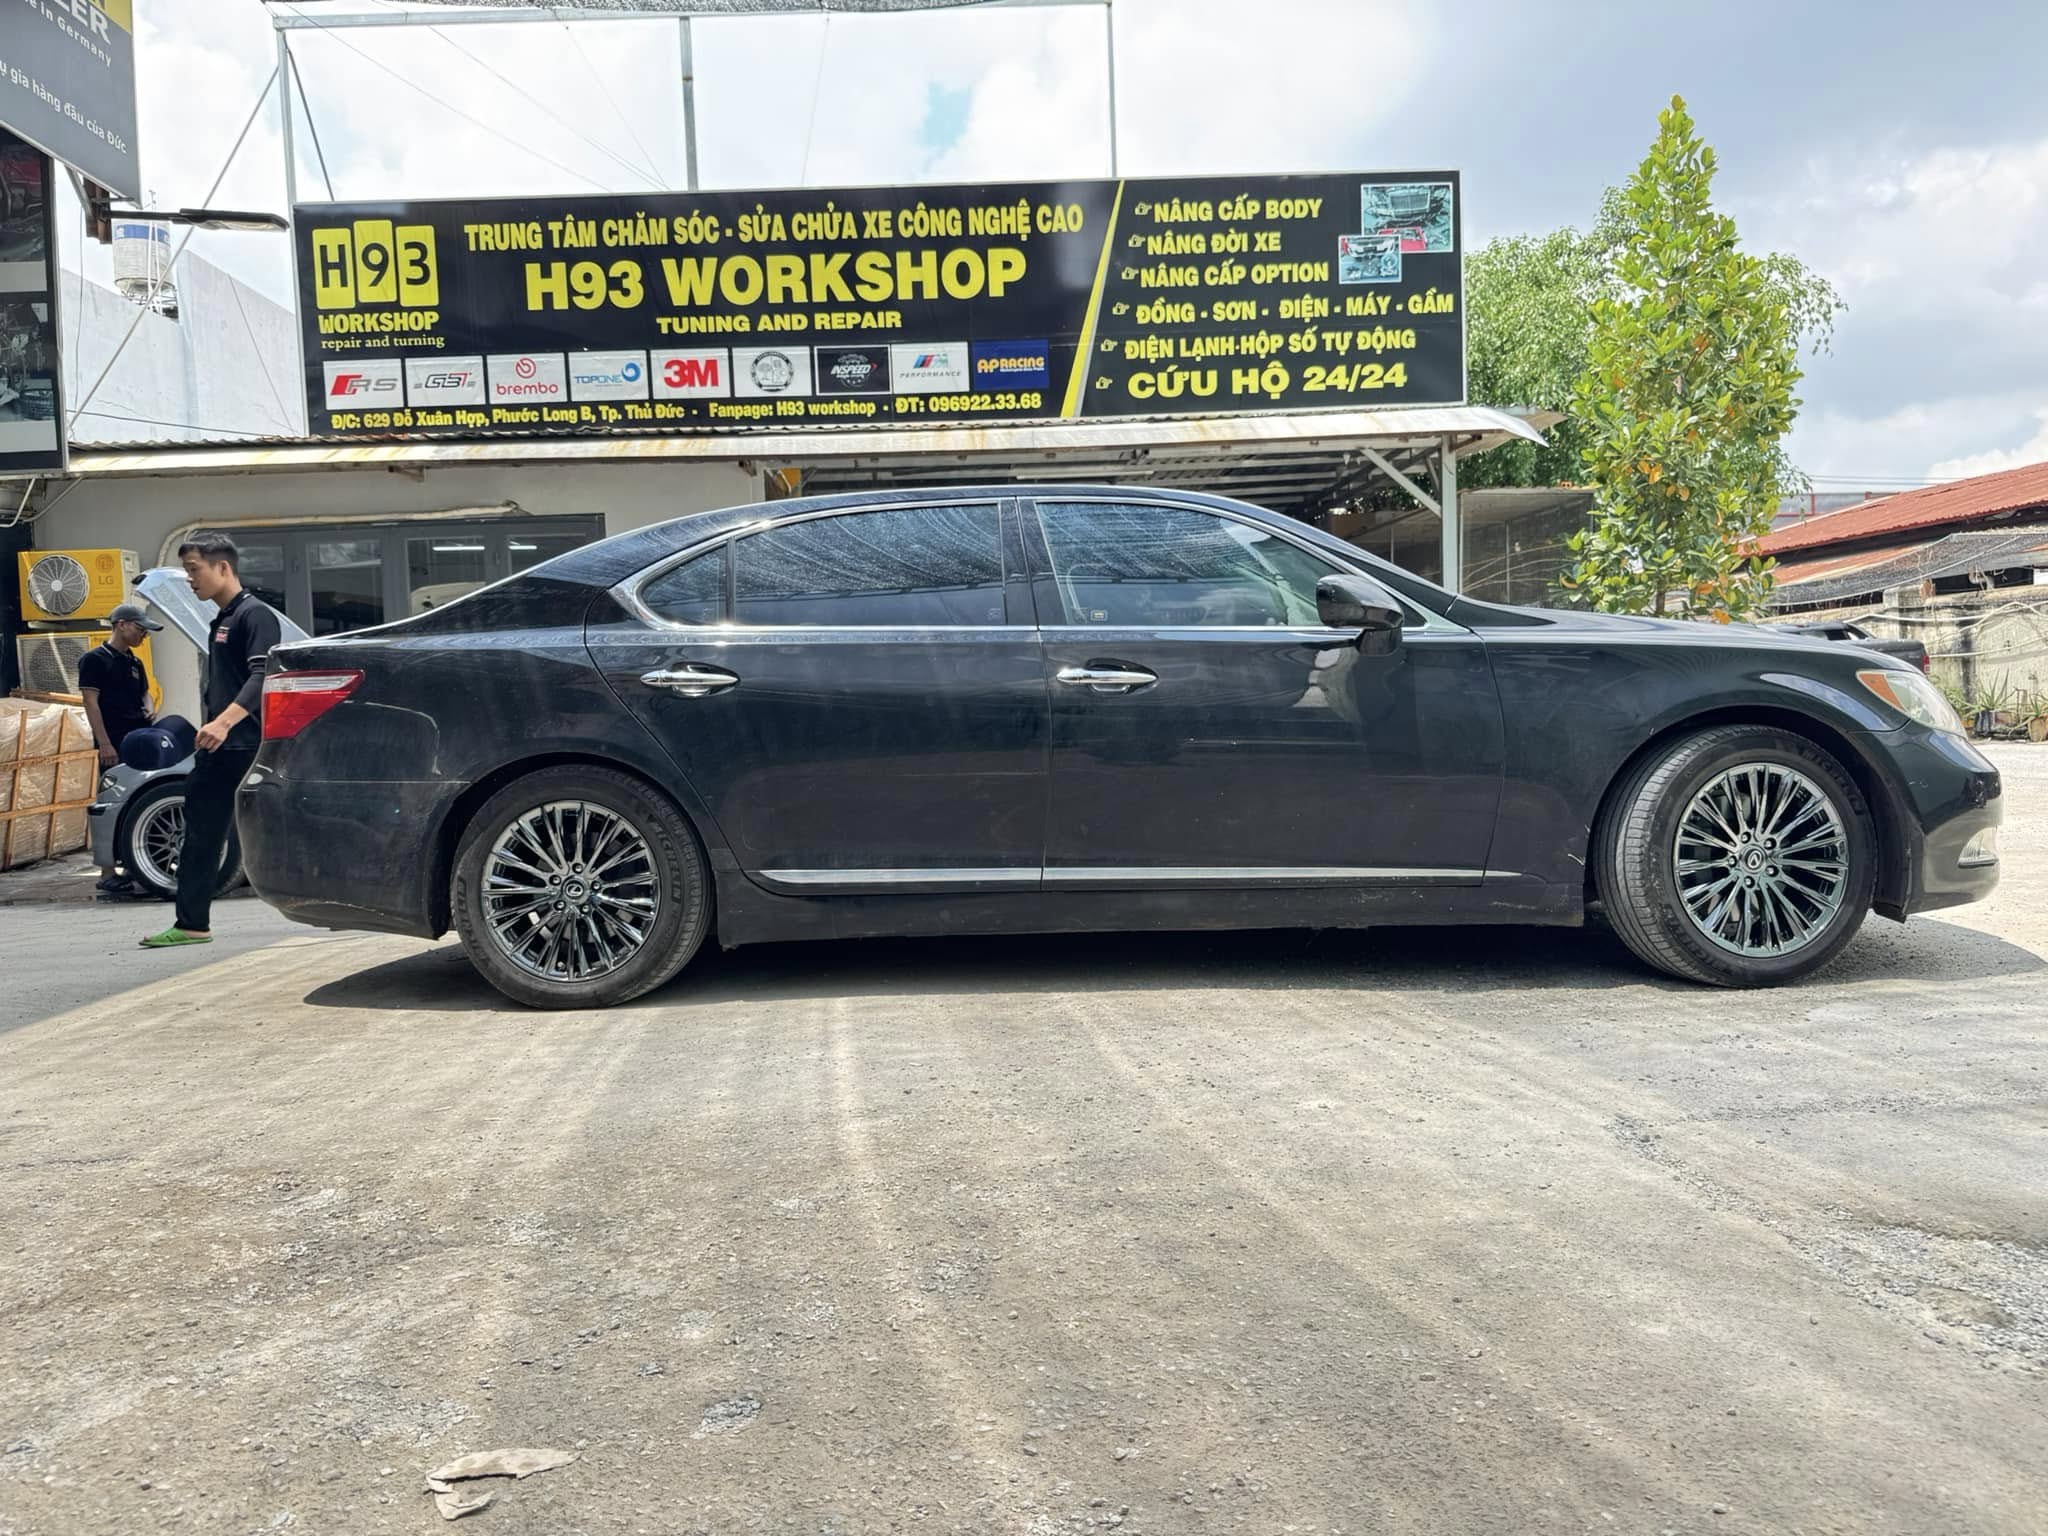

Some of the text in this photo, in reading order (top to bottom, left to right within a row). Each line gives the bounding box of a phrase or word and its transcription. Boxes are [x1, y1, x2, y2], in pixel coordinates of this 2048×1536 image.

[57, 16, 112, 67] Germany
[10, 68, 29, 88] gia
[32, 79, 60, 112] hàng
[64, 101, 84, 126] đầu
[87, 119, 104, 140] của
[107, 130, 127, 154] Đức
[463, 221, 543, 251] TRUNG
[547, 213, 597, 248] TÂM
[601, 212, 668, 247] CHĂM
[673, 210, 719, 245] SÓC
[737, 204, 787, 243] SỬA
[863, 210, 893, 239] XE
[897, 202, 962, 238] CÔNG
[967, 198, 1031, 241] NGHỆ
[1035, 203, 1083, 234] CAO
[1154, 195, 1321, 222] NÂNG CẤP BODY
[1146, 228, 1280, 255] NÂNG ĐỜI XE
[319, 241, 431, 290] H93
[525, 247, 1027, 311] H93 WORKSHOP
[1140, 259, 1329, 288] NÂNG CẤP OPTION
[317, 310, 439, 334] WORKSHOP
[655, 310, 902, 334] TUNING AND REPAIR
[1135, 296, 1196, 324] ĐỒNG
[1212, 300, 1257, 321] SƠN
[1279, 294, 1328, 322] ĐIỆN
[1345, 292, 1391, 316] MÁY
[1407, 288, 1454, 314] GẦM
[320, 334, 445, 351] repair and turning
[1125, 334, 1173, 363] ĐIỆN
[1287, 327, 1317, 353] SỐ
[1321, 331, 1352, 355] TỰ
[1356, 325, 1416, 354] ĐỘNG
[496, 382, 559, 396] brembo
[663, 359, 719, 388] 3M
[1127, 360, 1407, 400] CỨU HỘ 24/24
[330, 413, 361, 429] Đ/C:
[362, 412, 391, 428] 629
[392, 408, 414, 427] Đỗ
[415, 410, 453, 426] Xuân
[455, 409, 489, 427] Hợp,
[492, 405, 539, 424] Phước
[542, 406, 578, 424] Long
[580, 405, 596, 422] B,
[597, 404, 621, 422] Tp.
[624, 402, 652, 419] Thủ
[654, 403, 684, 418] Đức
[708, 402, 773, 419] Fanpage:
[776, 400, 805, 416] H93
[807, 399, 876, 416] workshop
[894, 396, 925, 414] ĐT:
[928, 392, 1041, 413] 096922.33.68
[98, 575, 114, 585] LG
